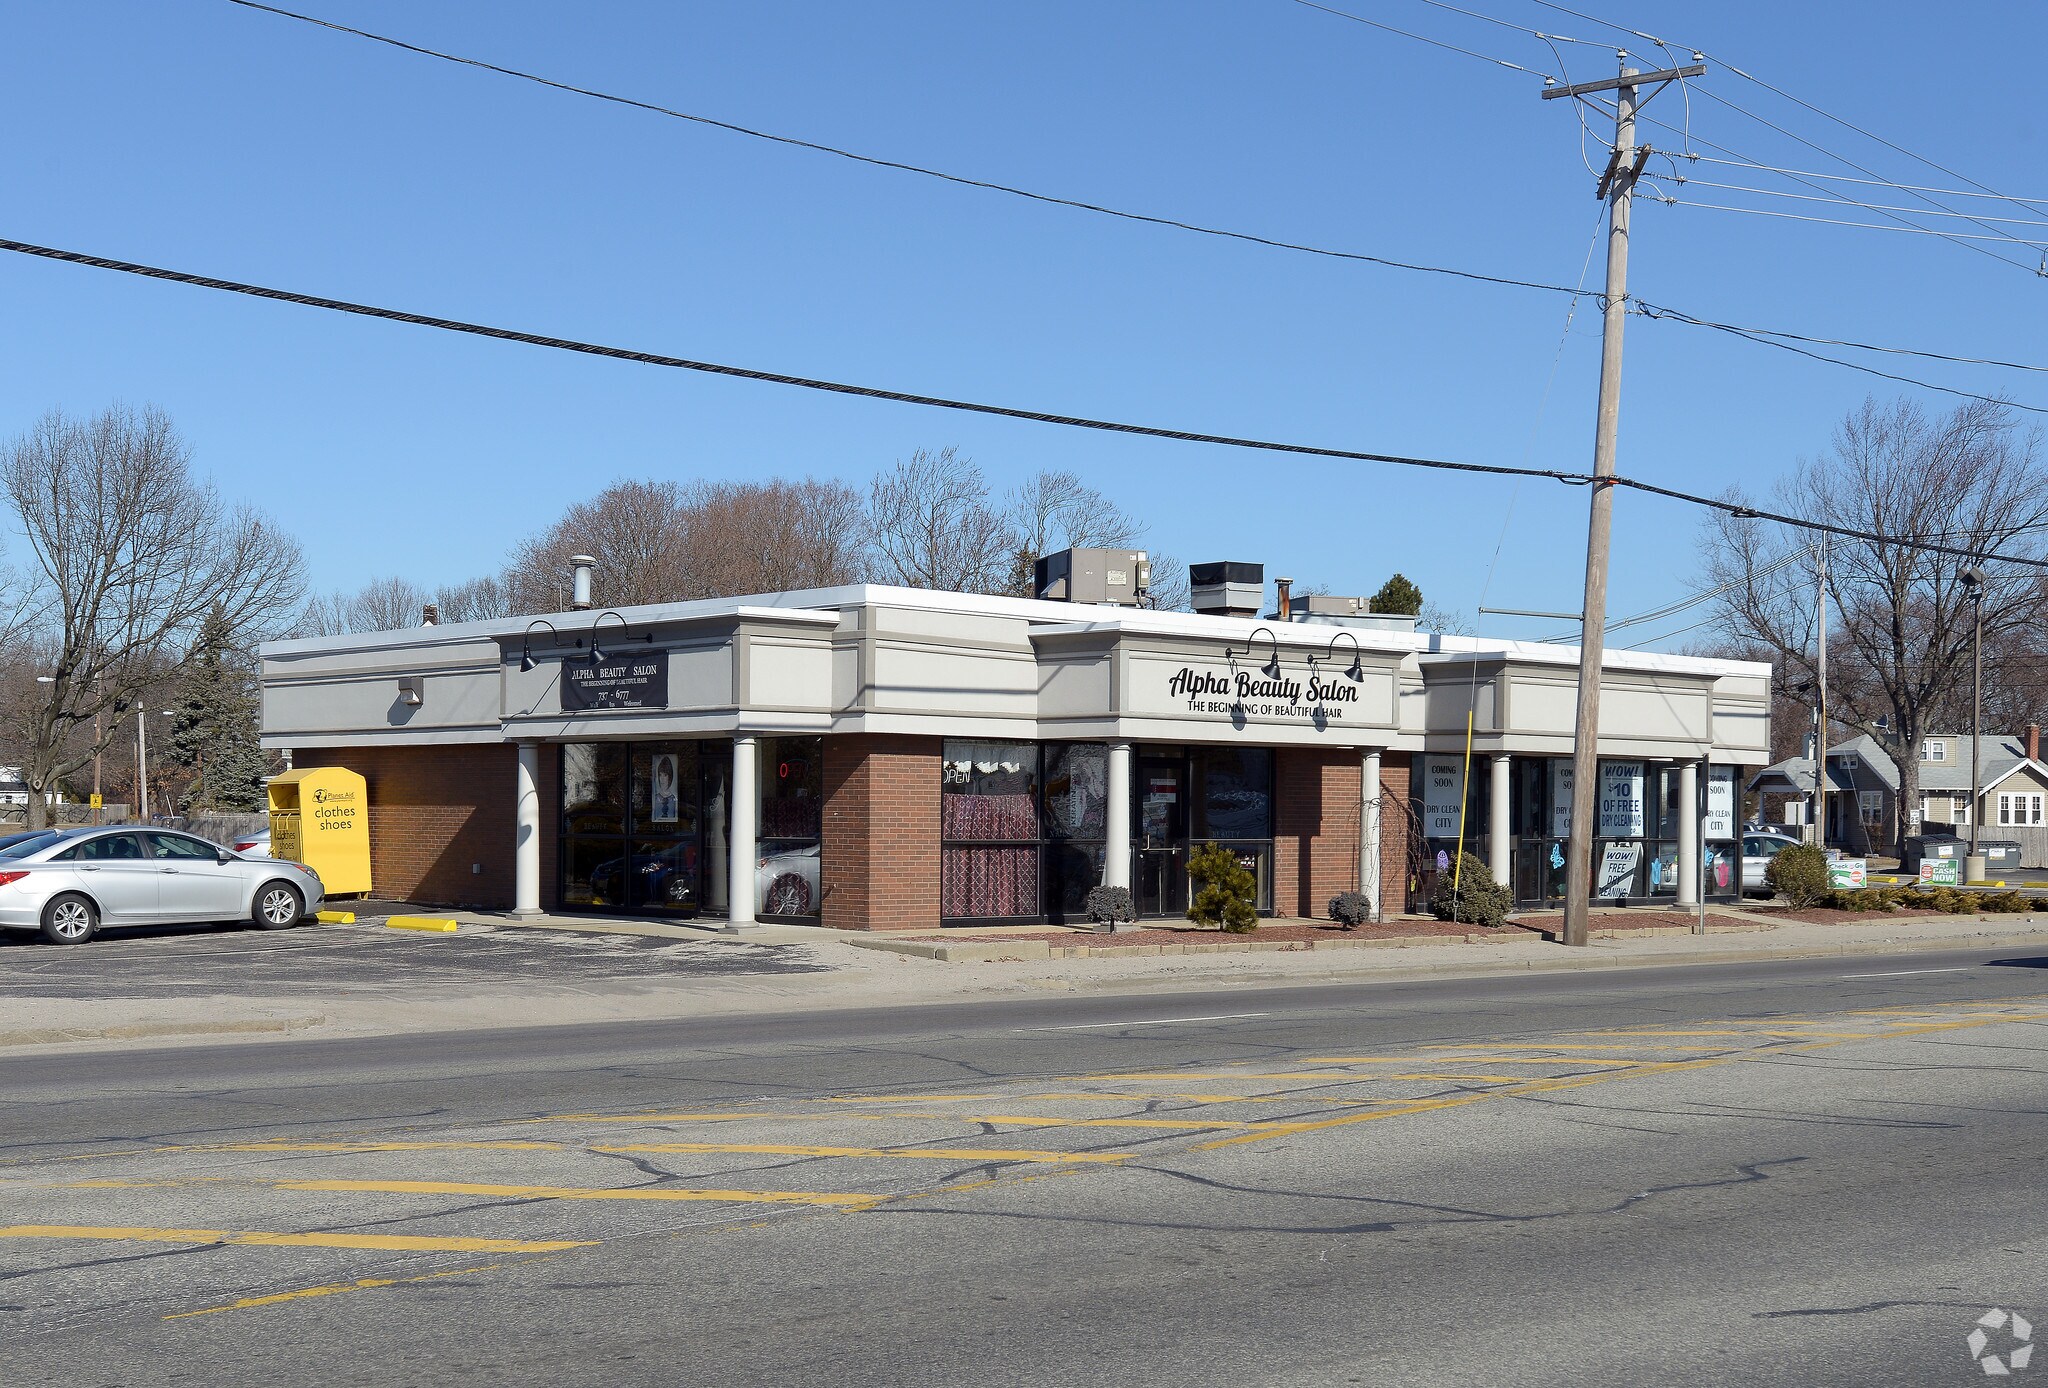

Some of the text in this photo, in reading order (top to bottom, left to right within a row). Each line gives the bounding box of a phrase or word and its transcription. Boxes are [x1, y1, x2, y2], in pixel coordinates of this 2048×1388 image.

[571, 664, 657, 680] ALPHA BEAUTY SALON
[1169, 668, 1359, 706] Alpha Beauty Salon
[615, 690, 630, 700] 6777
[1187, 701, 1342, 718] THE BEGINNING OF BEAUTIFUL HAIR
[1432, 765, 1457, 775] COMING
[1605, 765, 1639, 778] WOW!
[1434, 778, 1454, 788] SOON
[1426, 804, 1461, 814] DRY CLEAN
[1556, 806, 1567, 814] DRY
[1603, 800, 1639, 812] OF FREE
[314, 806, 355, 818] clothes
[320, 819, 352, 830] shoes
[1435, 818, 1453, 828] CITY
[1602, 814, 1641, 827] DRY CLEANING
[1710, 821, 1724, 830] CITY
[1606, 852, 1634, 860] WOW!
[1608, 863, 1626, 873] FREE
[1933, 874, 1954, 882] NOW
